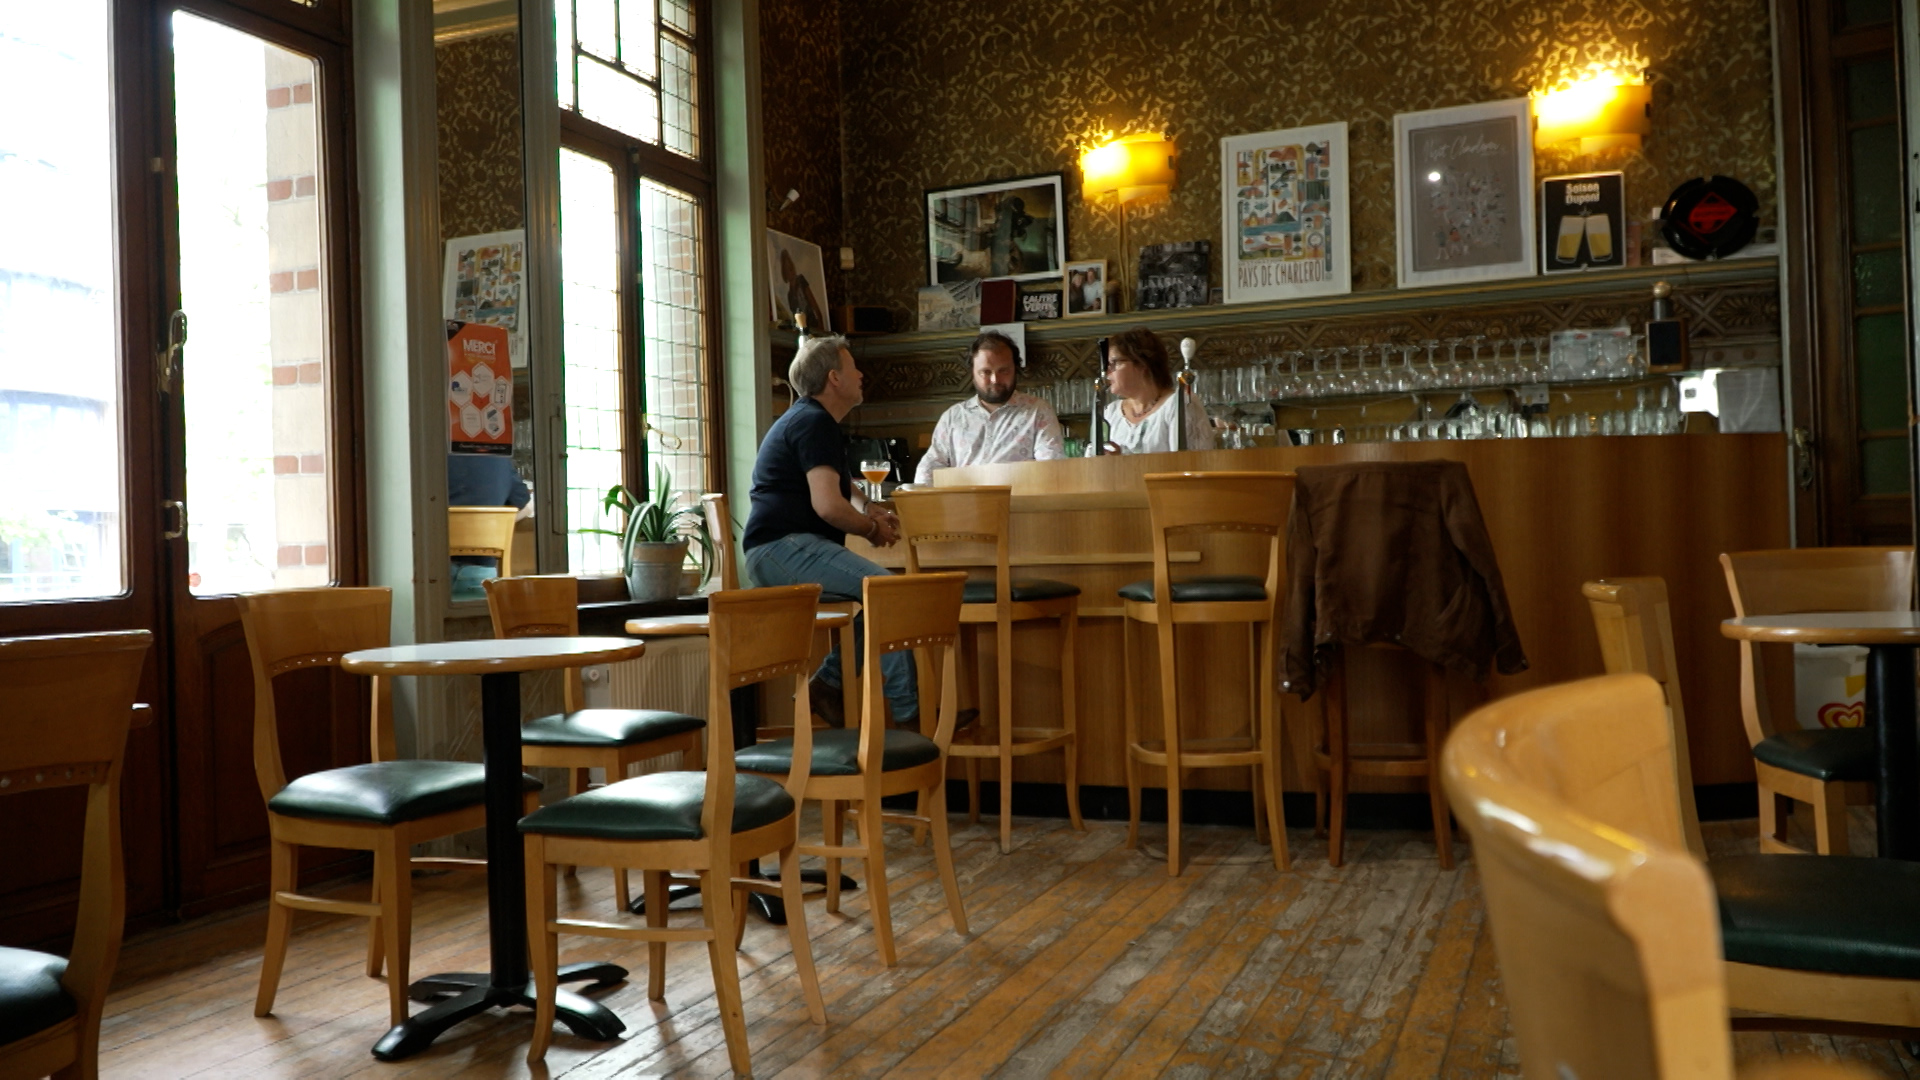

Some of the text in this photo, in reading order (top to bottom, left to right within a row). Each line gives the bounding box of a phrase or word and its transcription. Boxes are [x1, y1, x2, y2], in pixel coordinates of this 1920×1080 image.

[1566, 193, 1600, 205] Dupont
[1238, 260, 1326, 288] PAYS DE CHARLEROI
[463, 338, 496, 355] MERCI
